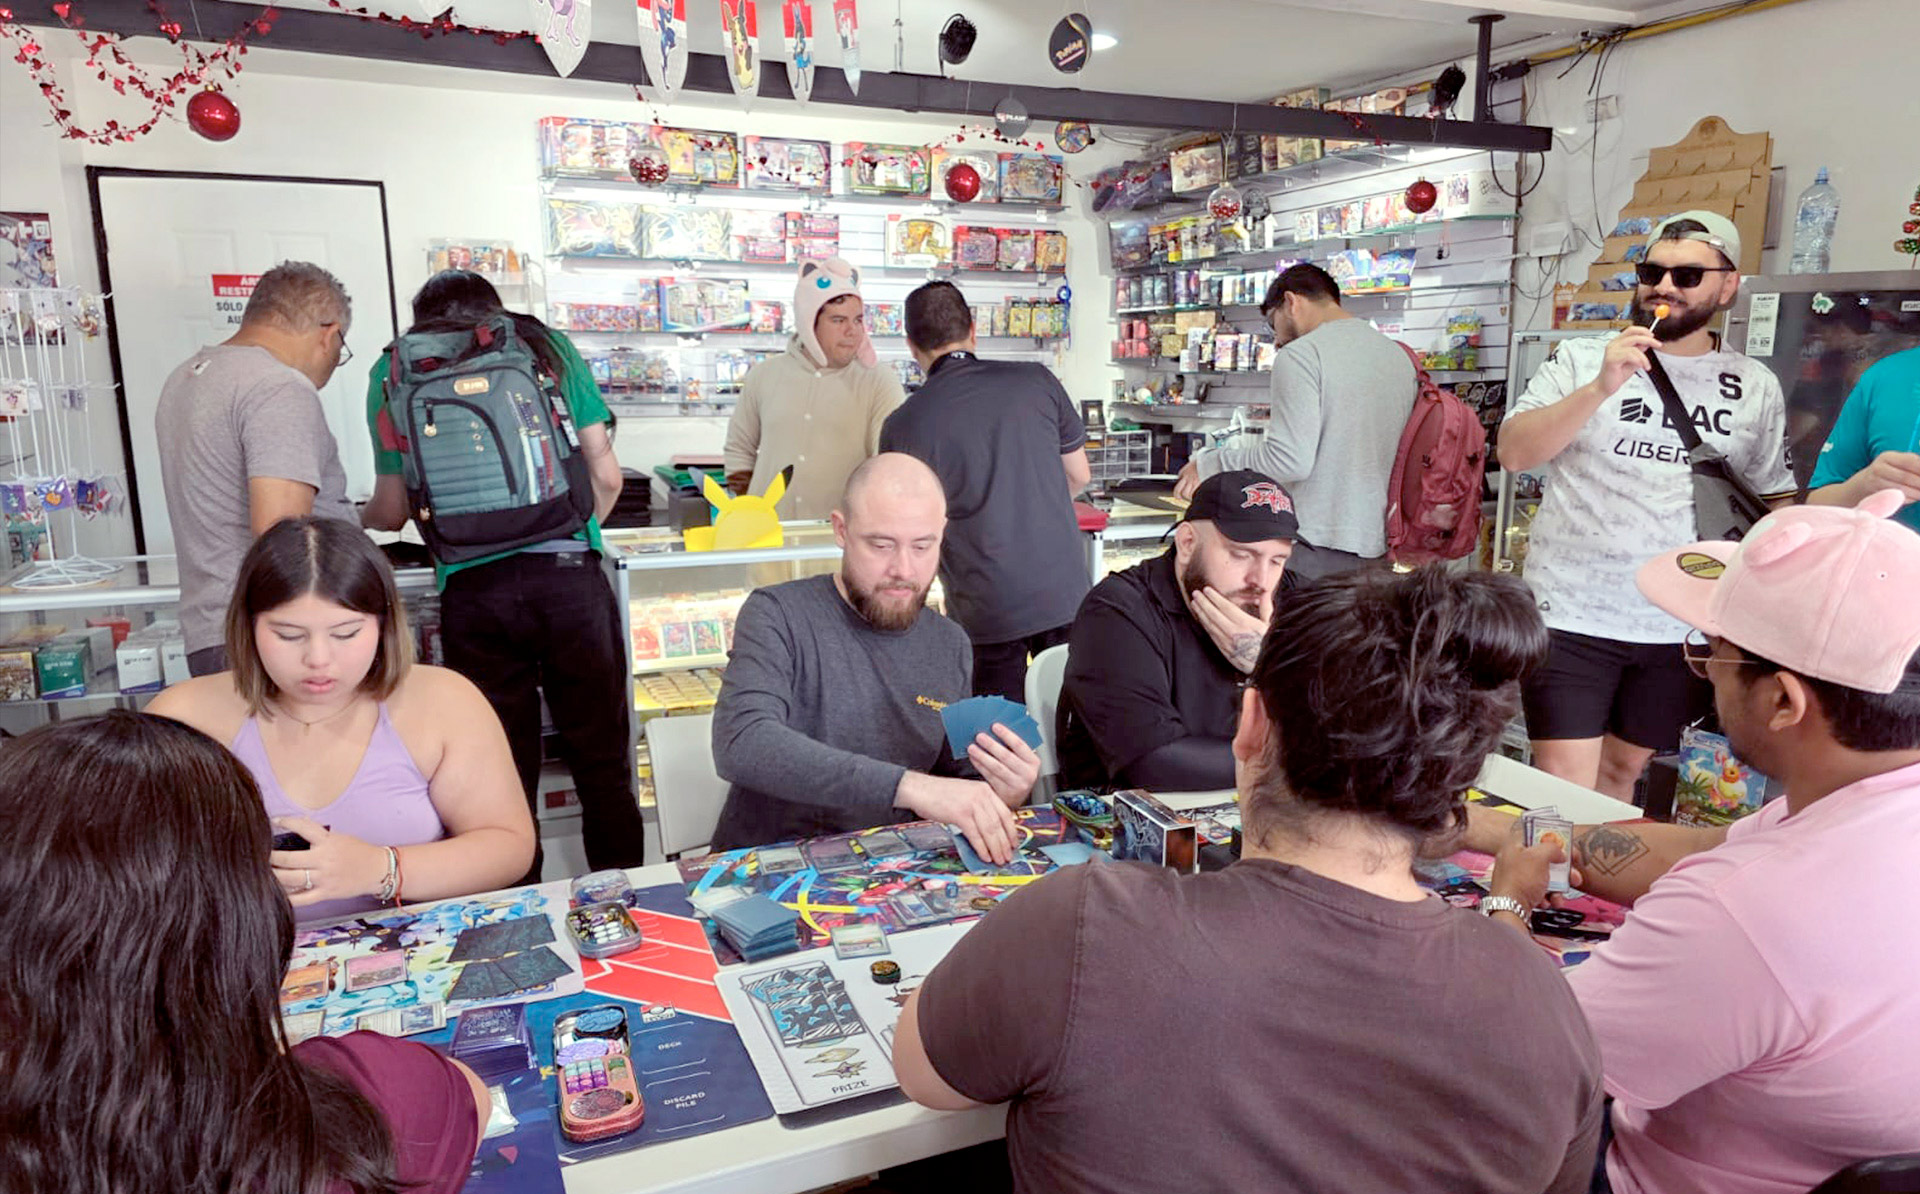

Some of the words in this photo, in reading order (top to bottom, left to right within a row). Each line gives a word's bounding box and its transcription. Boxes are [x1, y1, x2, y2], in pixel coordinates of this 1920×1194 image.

[1718, 372, 1742, 400] S
[1614, 438, 1692, 465] LIBER
[658, 1041, 682, 1051] DECK
[831, 1080, 869, 1094] PRIZE
[663, 1091, 706, 1105] DISCARD
[675, 1100, 697, 1110] PILE
